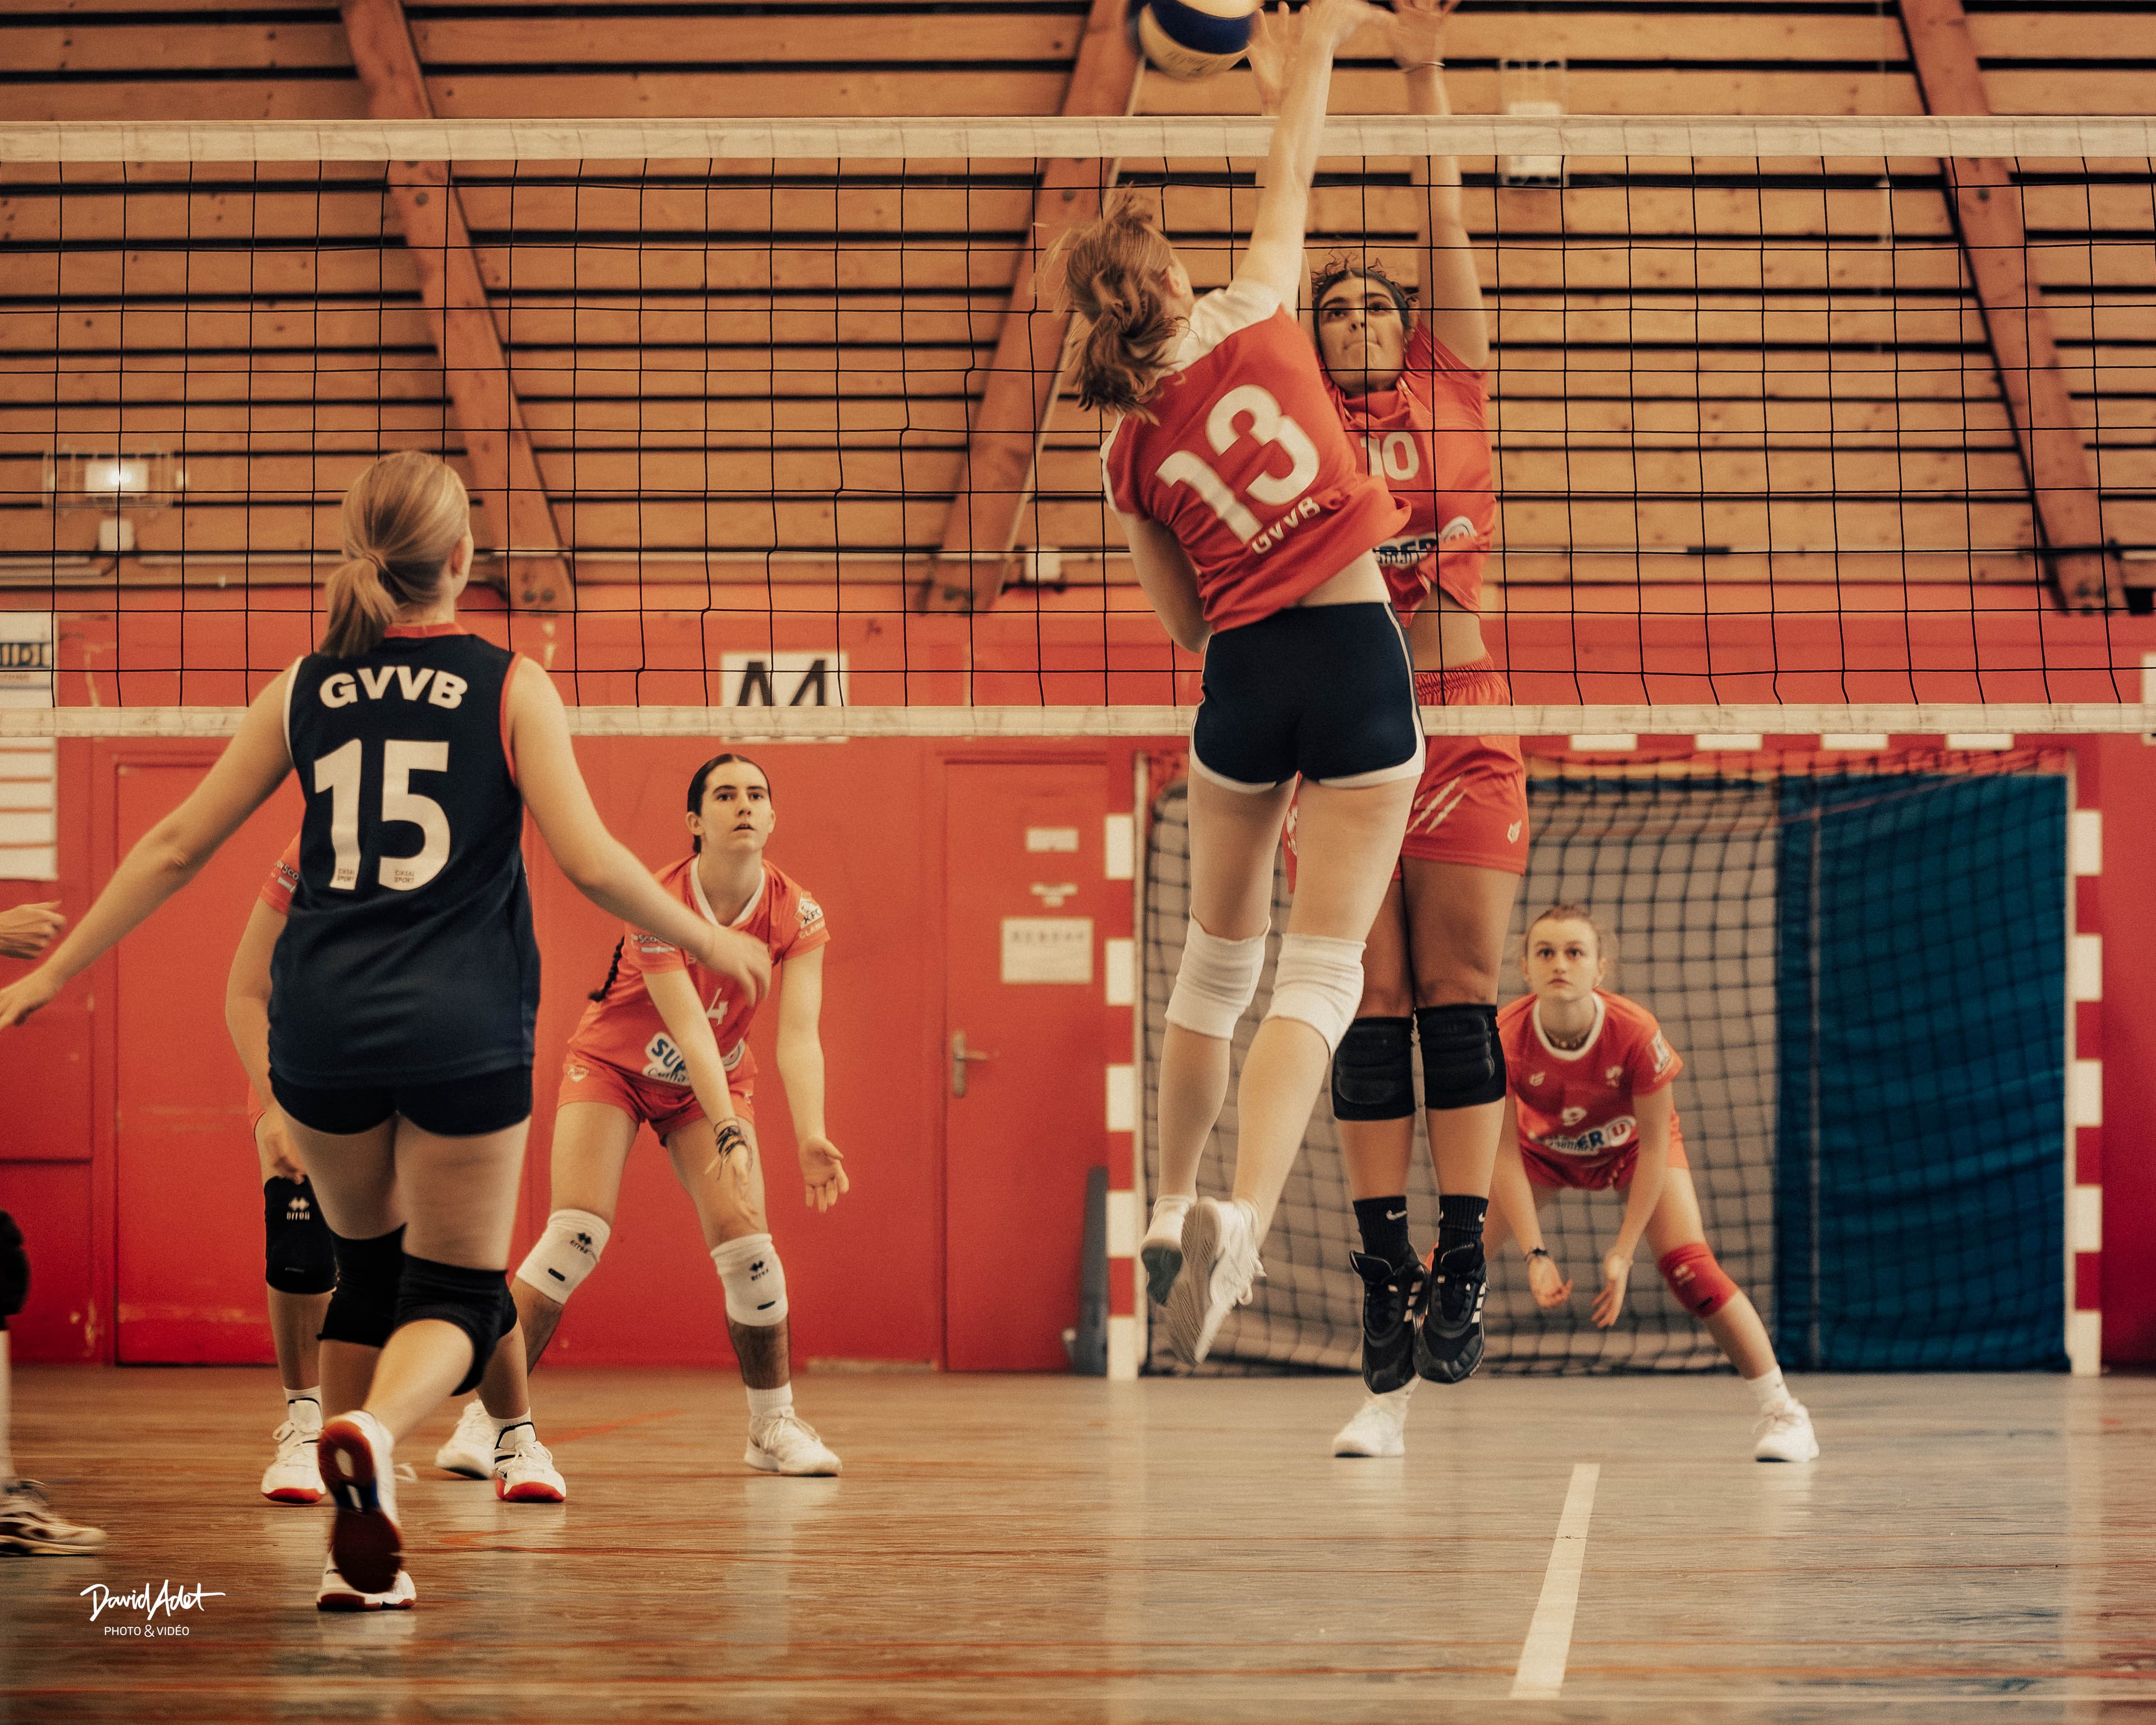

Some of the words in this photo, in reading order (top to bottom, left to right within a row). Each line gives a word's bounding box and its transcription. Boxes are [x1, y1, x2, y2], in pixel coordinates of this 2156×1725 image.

[1154, 384, 1320, 545] 13
[1360, 431, 1419, 481] 10
[1251, 496, 1321, 554] GVVB
[319, 665, 468, 710] GVVB
[314, 737, 450, 891] 15
